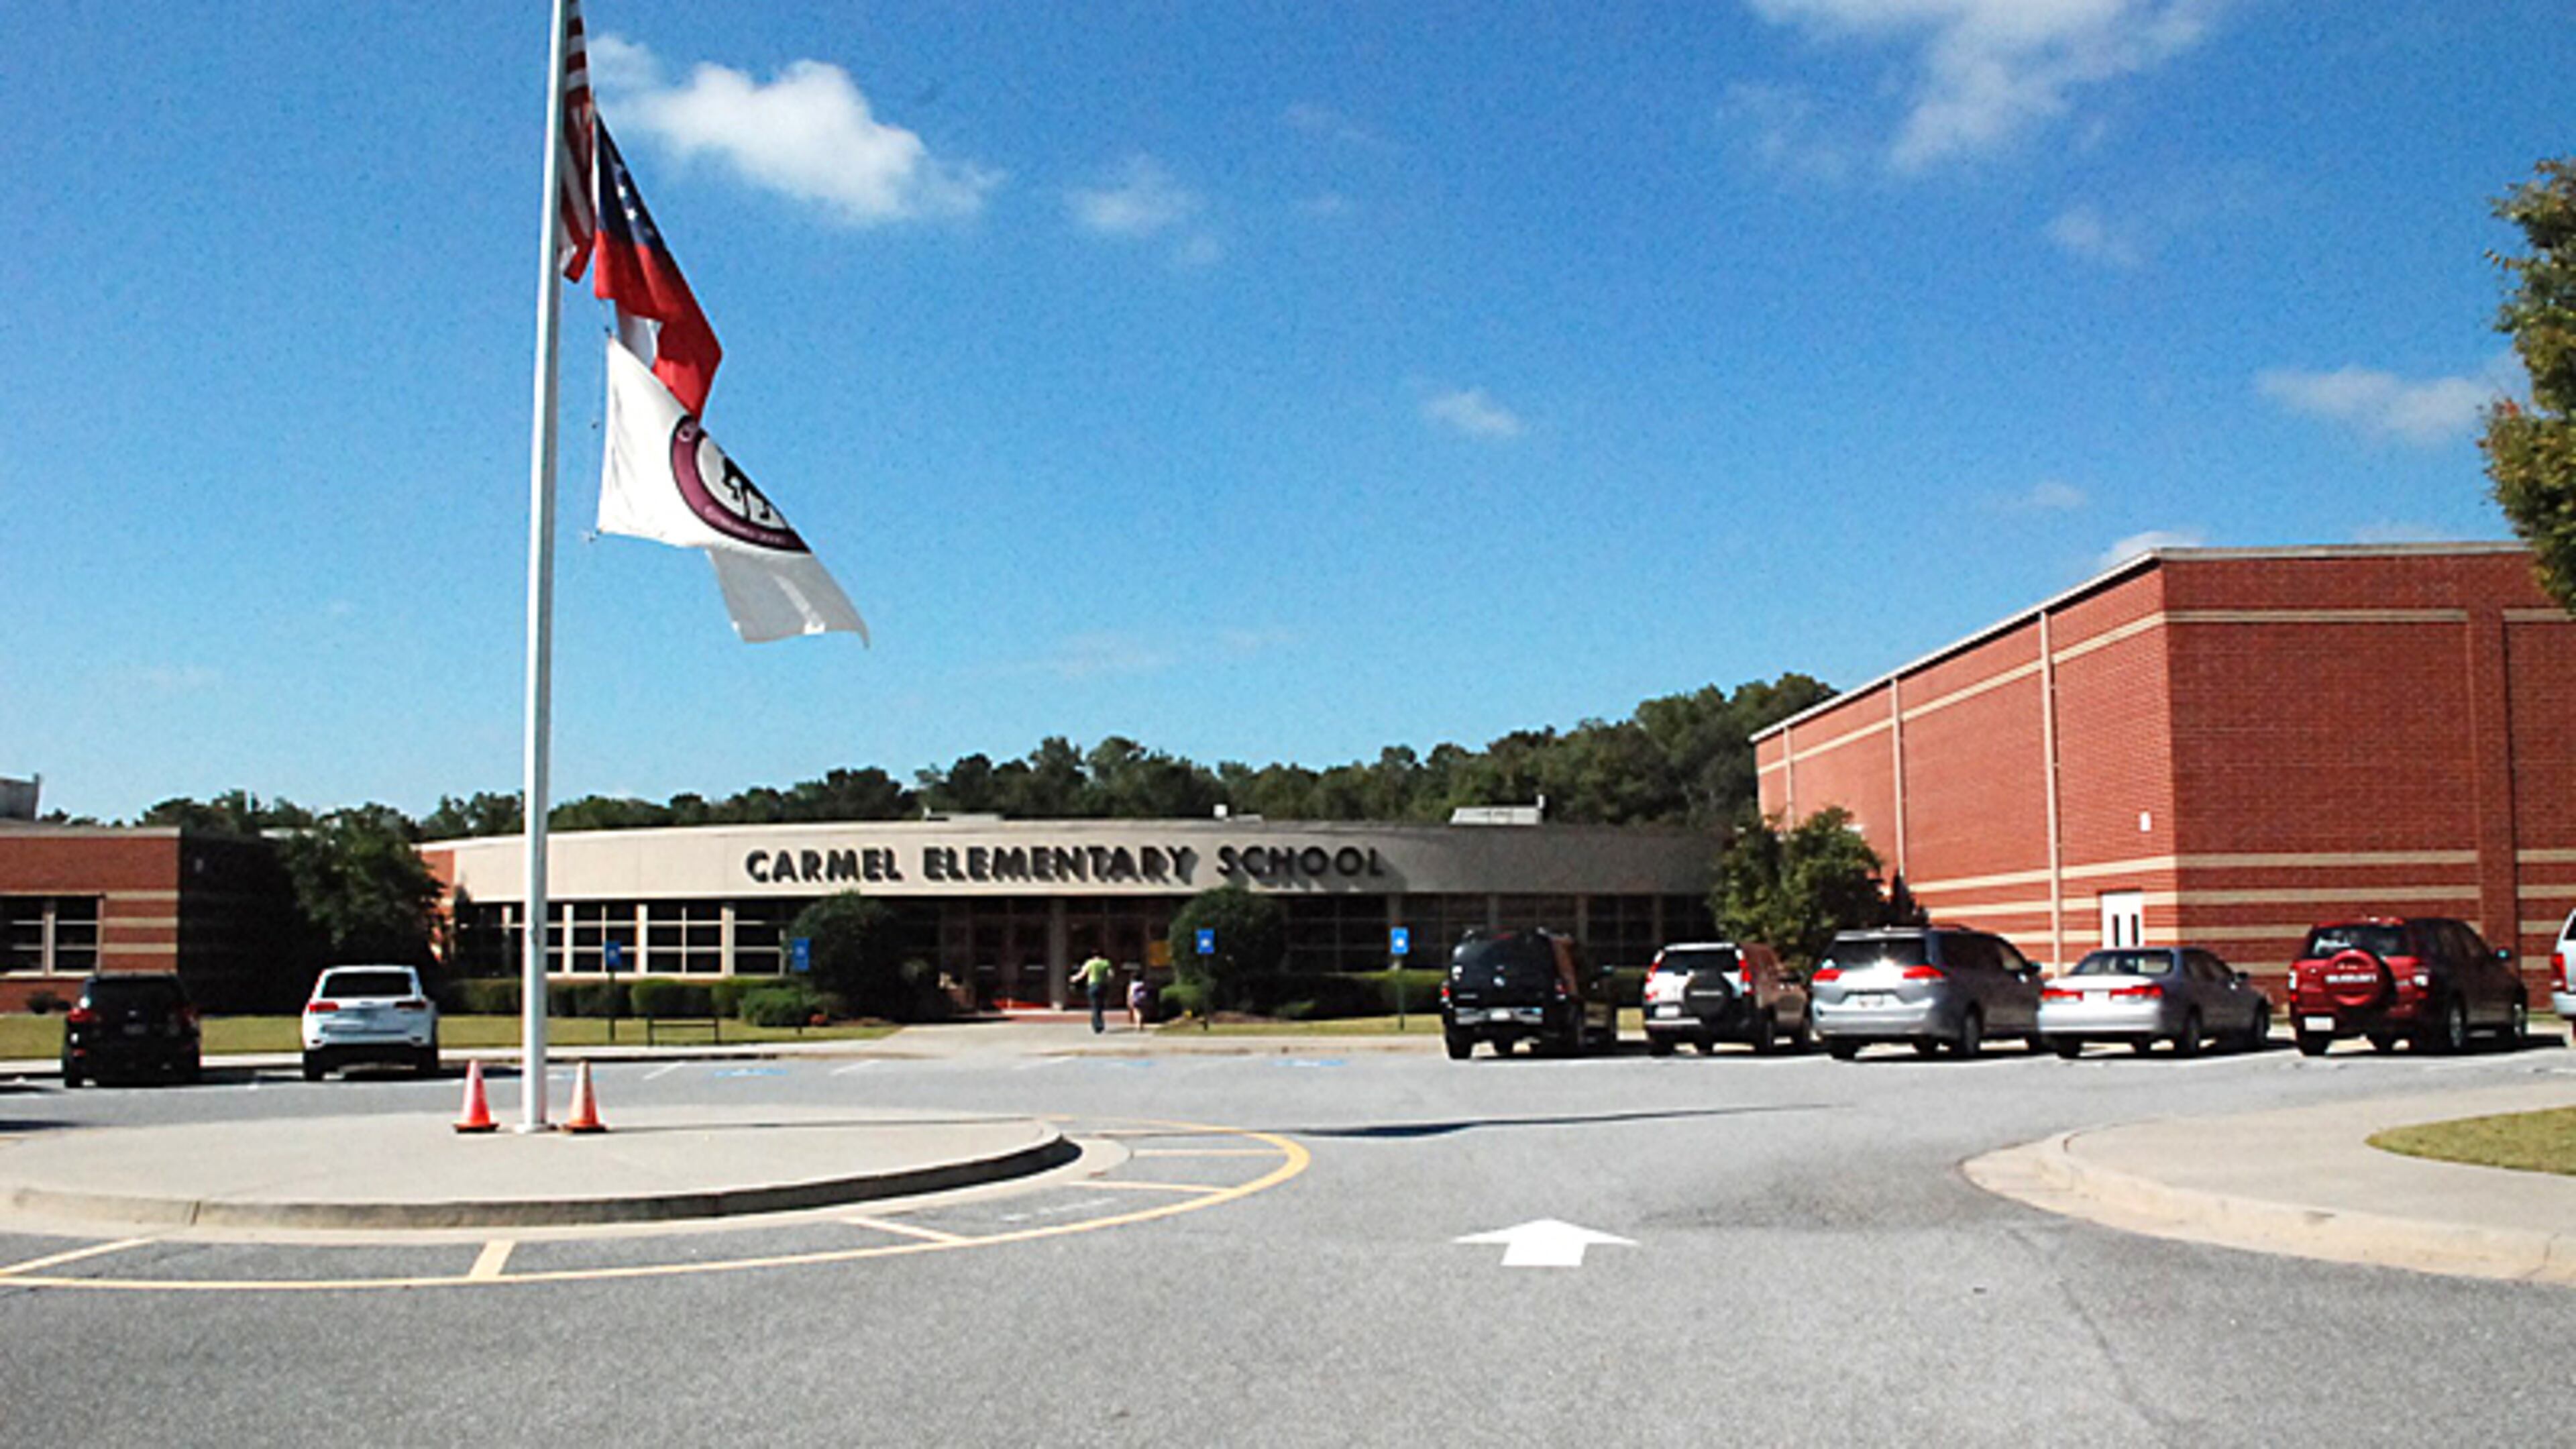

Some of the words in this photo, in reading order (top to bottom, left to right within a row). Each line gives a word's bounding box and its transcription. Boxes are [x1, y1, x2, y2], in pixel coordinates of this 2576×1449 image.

[746, 847, 904, 883] CARMEL
[923, 846, 1194, 883] ELEMENTARY
[1216, 846, 1385, 877] SCHOOL
